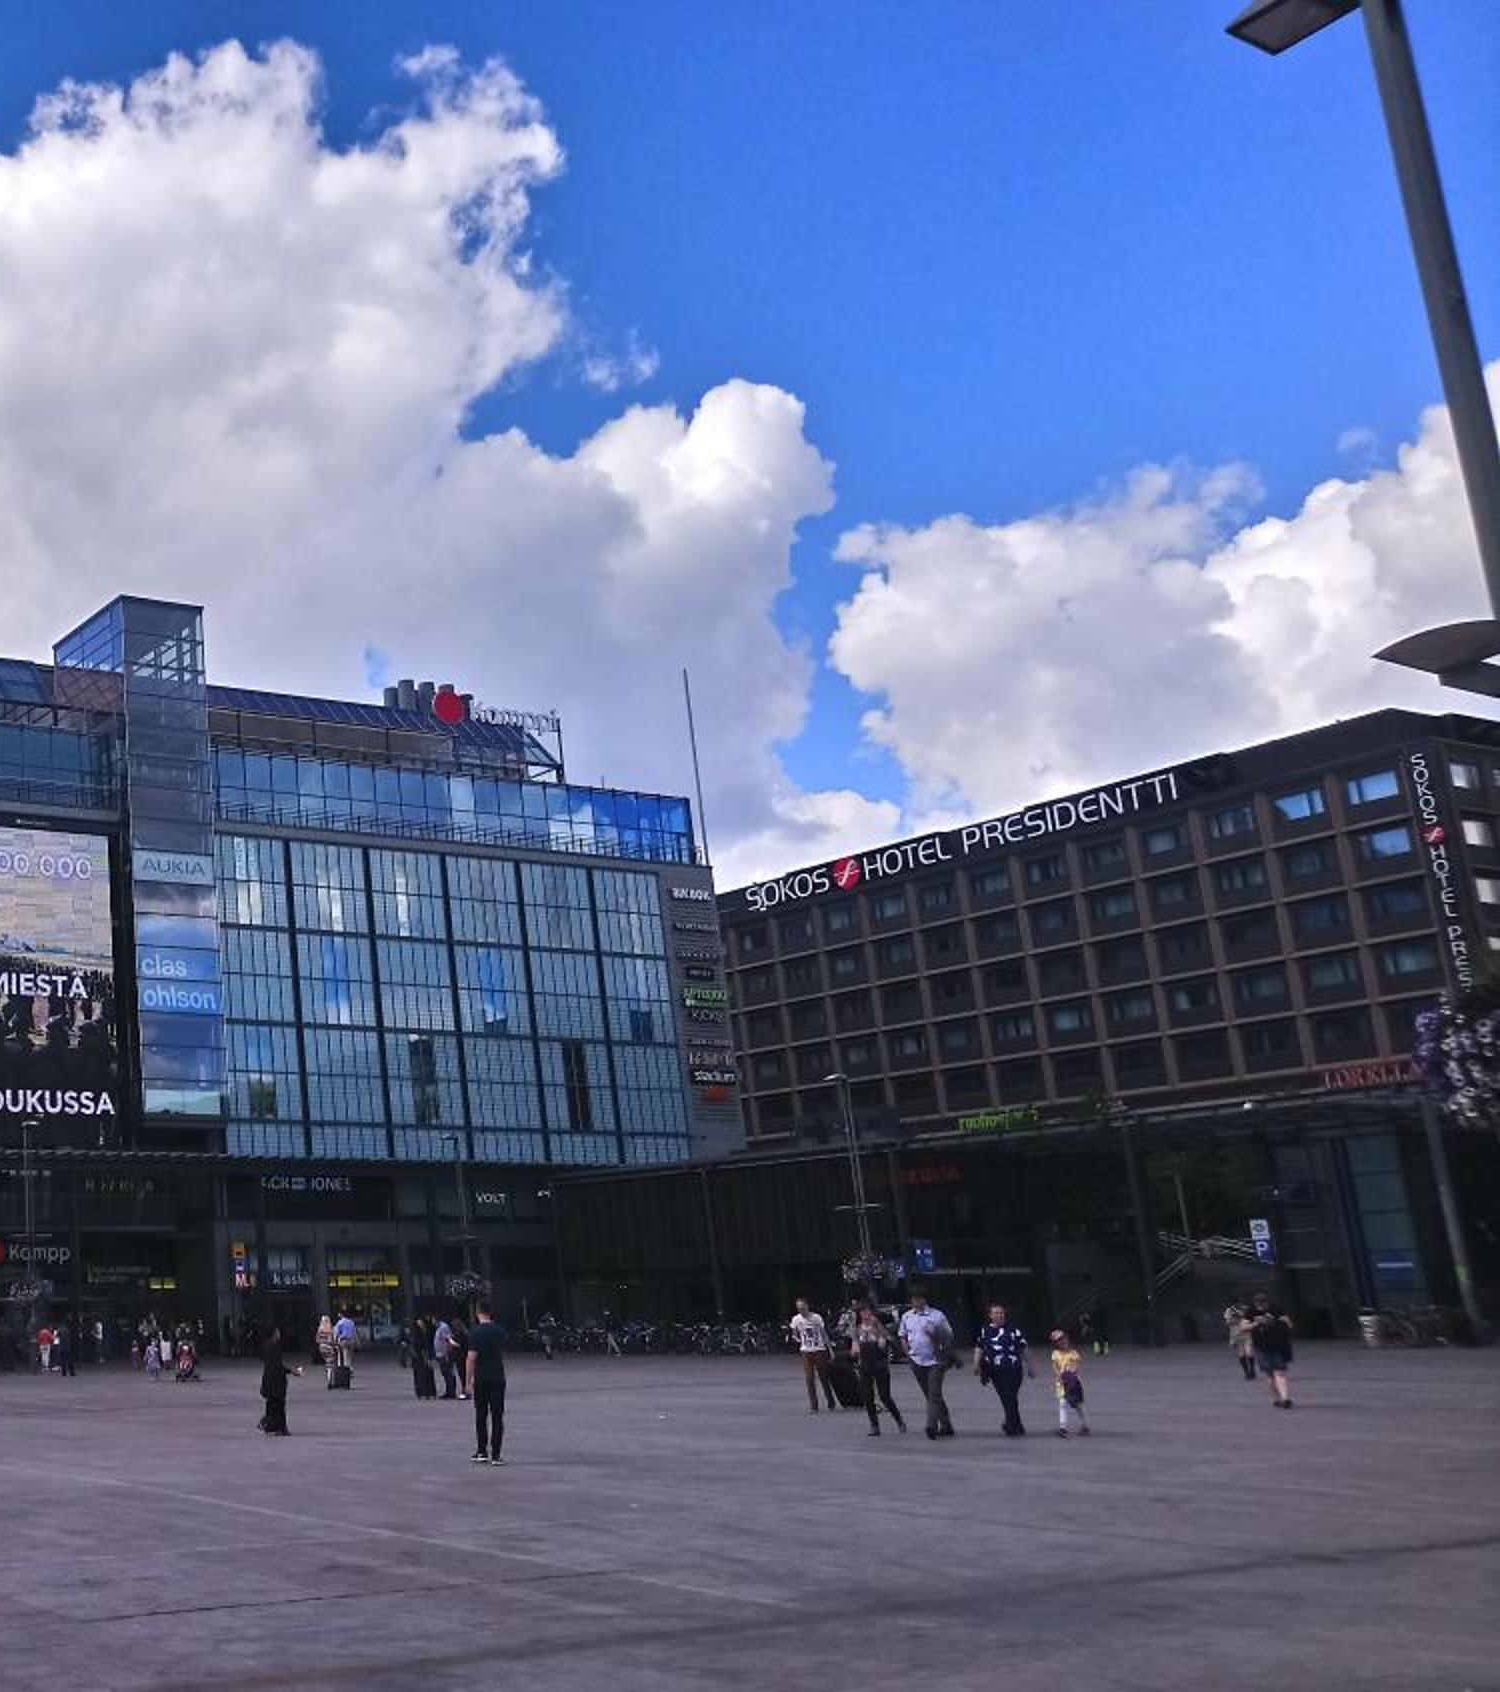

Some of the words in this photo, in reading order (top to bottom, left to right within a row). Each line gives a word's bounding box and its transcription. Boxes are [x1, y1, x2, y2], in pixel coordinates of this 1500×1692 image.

[745, 867, 830, 912] SOKOS
[862, 837, 952, 881] HOTEL
[961, 772, 1178, 854] PRESIDENTTI
[1411, 753, 1437, 825] SOKOS
[1429, 845, 1458, 918] HOTEL
[39, 855, 92, 880] 000
[142, 859, 205, 875] AUKIA
[142, 954, 188, 977] clas
[143, 985, 217, 1010] ohlson
[475, 1192, 506, 1205] VOLT
[8, 1244, 71, 1265] Kampp
[1255, 1241, 1268, 1257] P
